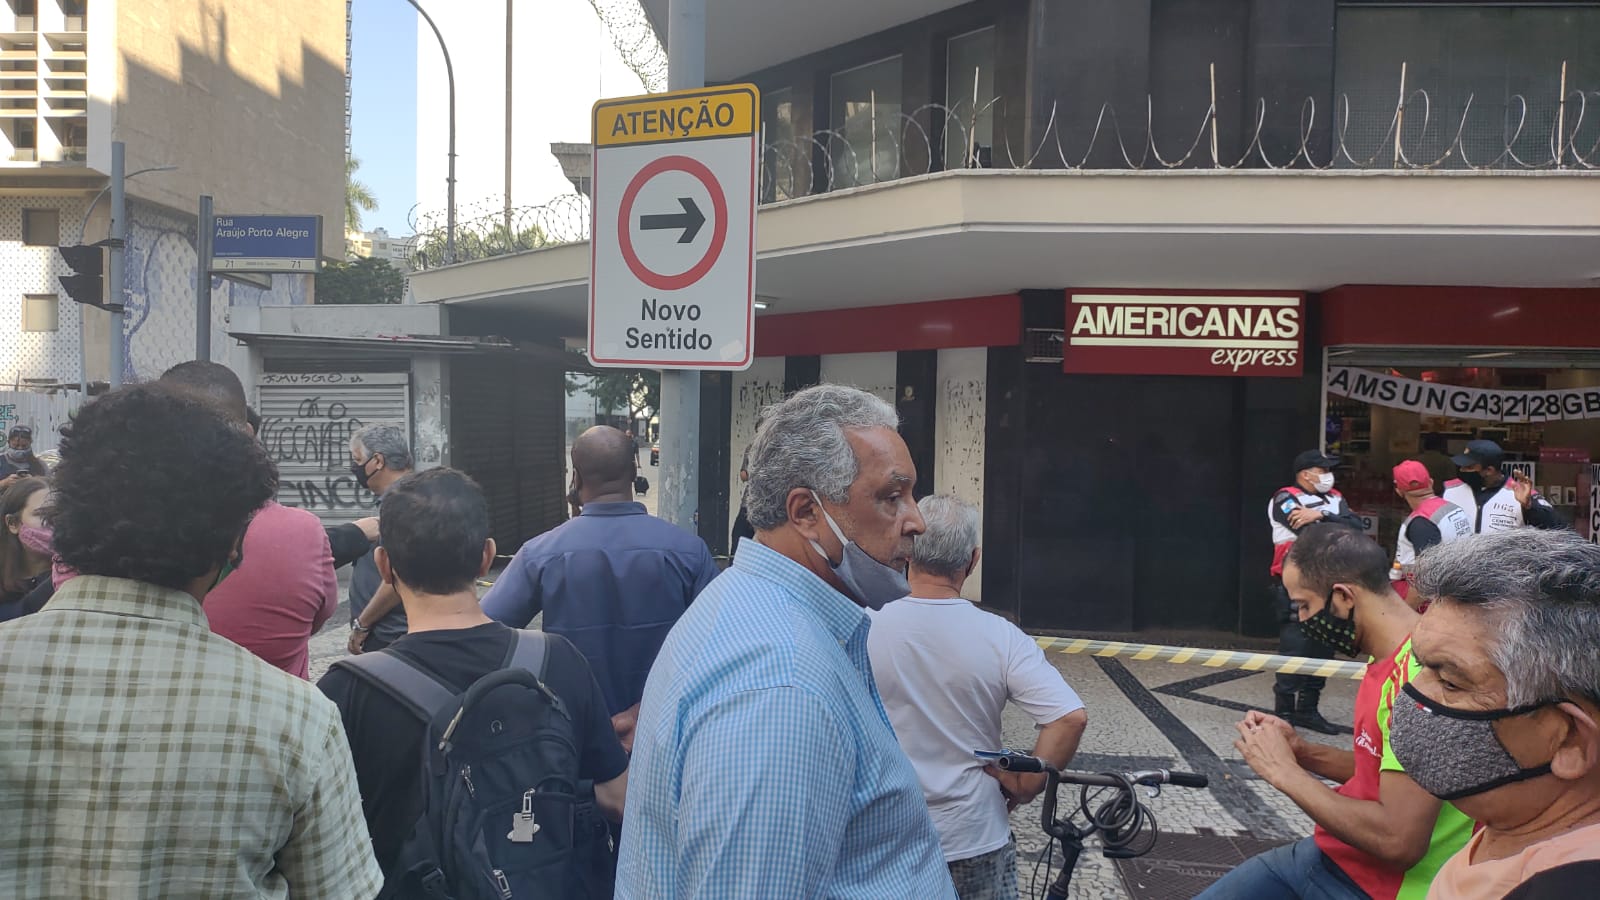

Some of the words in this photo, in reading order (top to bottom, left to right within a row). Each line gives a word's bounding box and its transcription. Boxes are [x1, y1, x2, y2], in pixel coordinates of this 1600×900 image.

[611, 99, 735, 137] ATENÇÃO
[216, 217, 234, 227] Rua
[216, 227, 246, 239] Araújo
[248, 227, 273, 238] Porto
[276, 228, 309, 240] Alegre
[225, 260, 234, 269] 71
[290, 260, 301, 269] 71
[641, 299, 701, 321] Novo
[1071, 305, 1300, 338] AMERICANAS
[625, 327, 713, 351] Sentido
[1210, 348, 1298, 372] express
